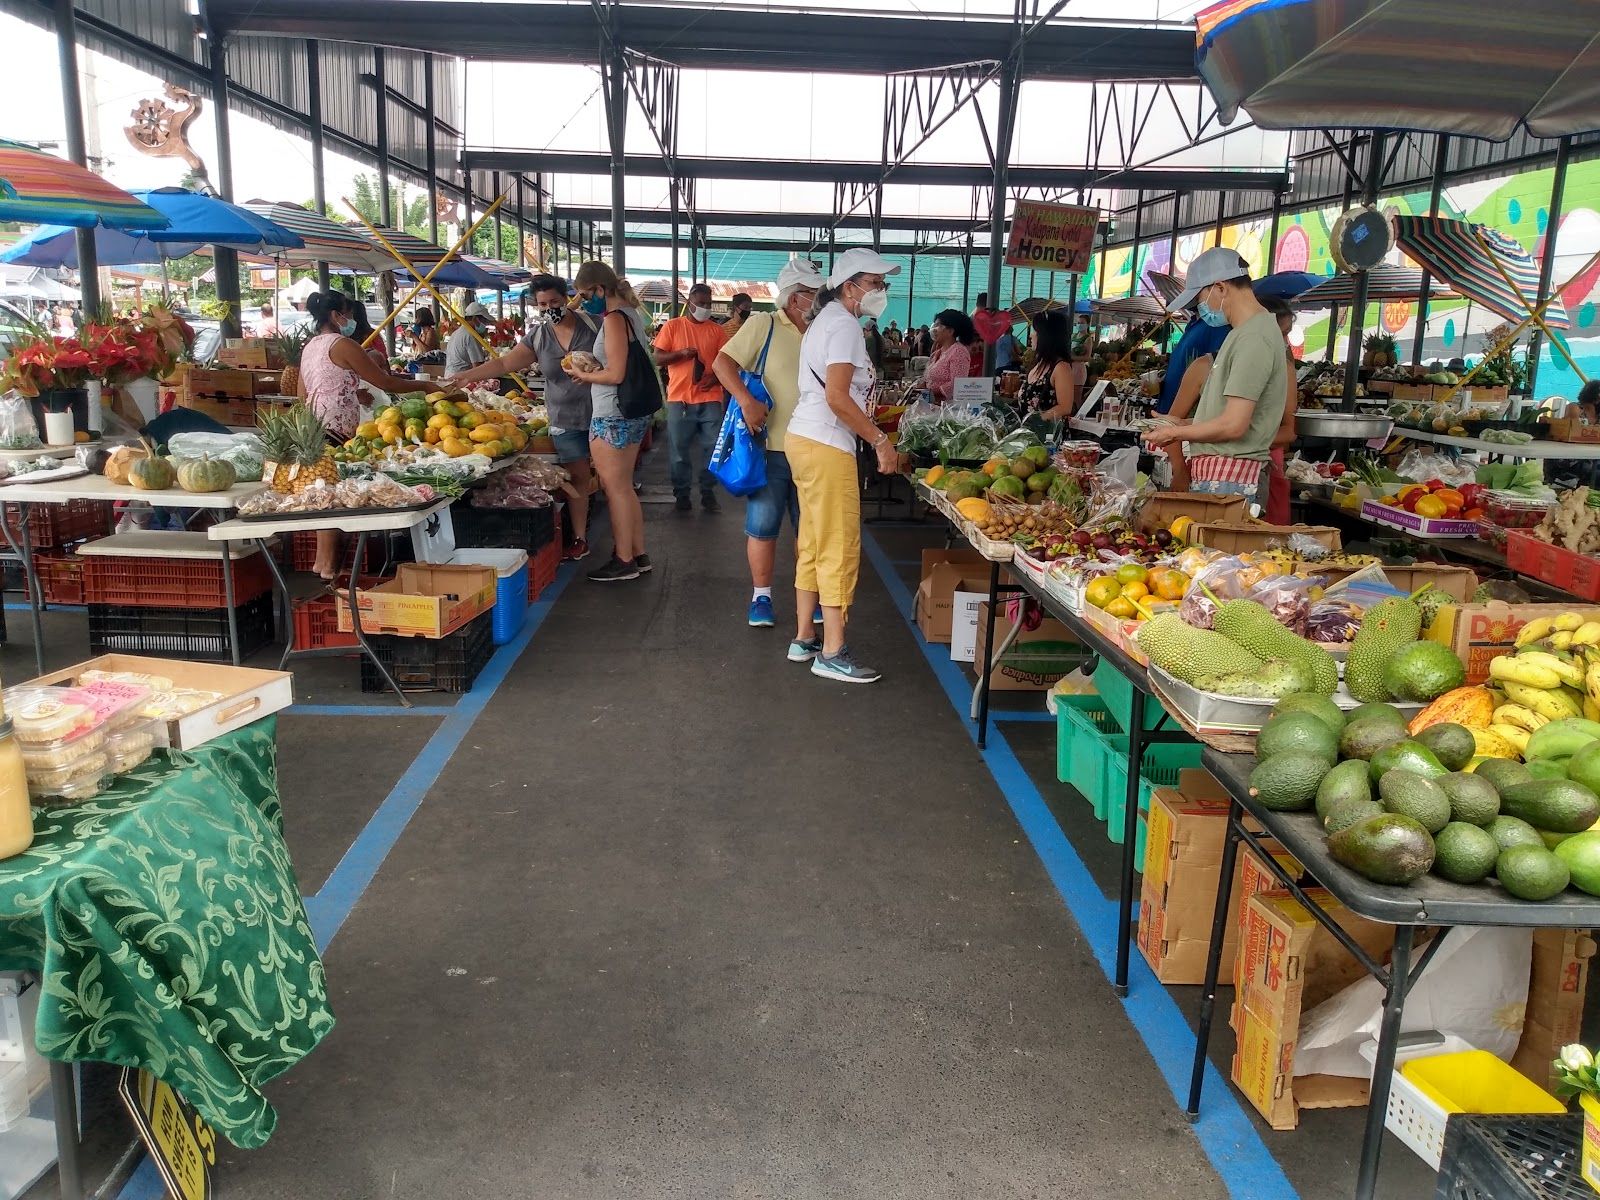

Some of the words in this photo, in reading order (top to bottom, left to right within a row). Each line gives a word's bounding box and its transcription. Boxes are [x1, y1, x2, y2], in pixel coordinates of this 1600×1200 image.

[1037, 209, 1098, 227] HAWAIIAN
[1017, 239, 1078, 268] Honey
[1382, 510, 1396, 521] FRESH
[397, 602, 434, 611] PINEAPPLES
[1002, 665, 1044, 686] Produce
[1268, 926, 1287, 991] Dole
[1258, 1036, 1270, 1106] PINEAPPLES
[161, 1095, 174, 1145] HOW
[172, 1111, 186, 1179] SWEET
[186, 1143, 197, 1172] IS
[185, 1164, 196, 1195] IT
